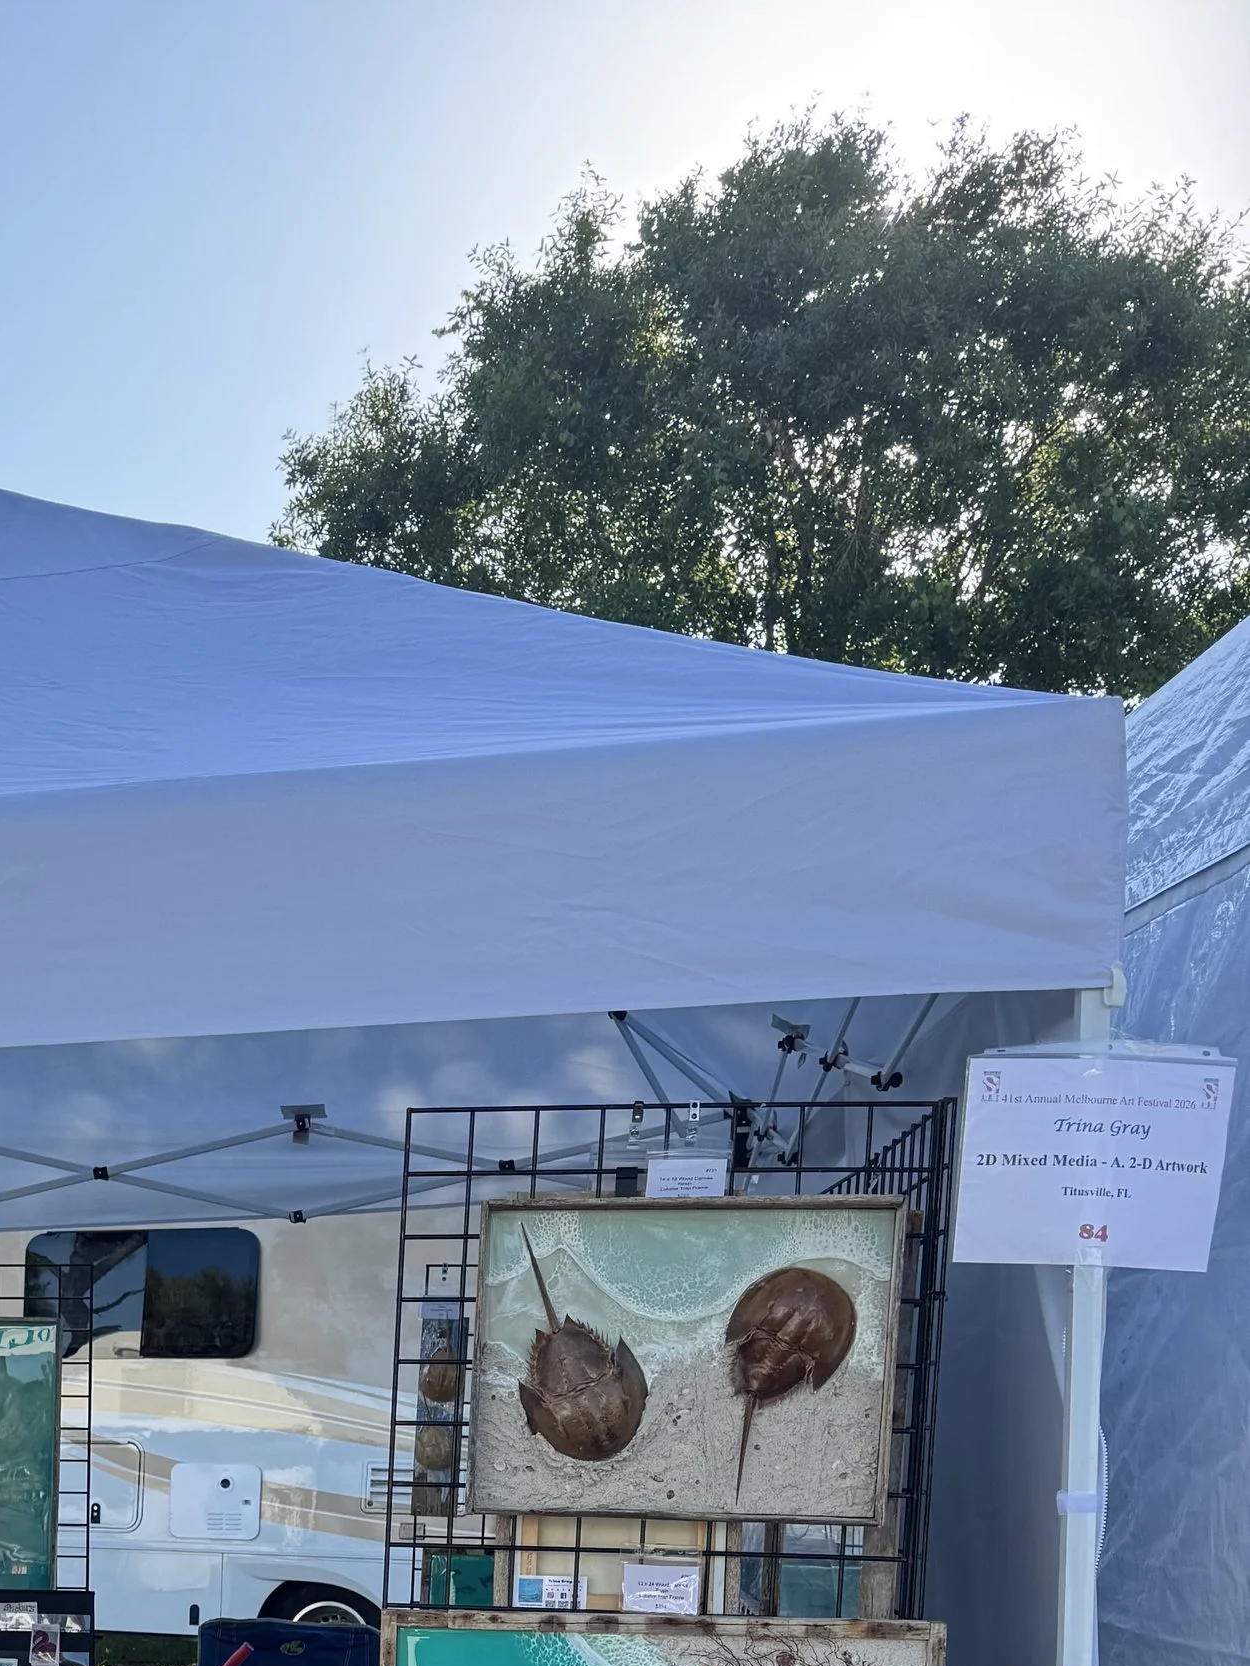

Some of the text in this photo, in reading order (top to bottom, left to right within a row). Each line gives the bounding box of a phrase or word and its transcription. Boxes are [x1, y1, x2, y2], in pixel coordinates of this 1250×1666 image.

[1001, 1094, 1023, 1104] 41st
[1024, 1094, 1062, 1104] Annual
[1064, 1094, 1118, 1105] Melbourne
[1119, 1096, 1135, 1106] Art
[1137, 1096, 1172, 1109] Festival
[1173, 1099, 1197, 1110] 2026
[1053, 1116, 1151, 1141] Trina Gray
[976, 1153, 997, 1166] 2D
[1001, 1153, 1048, 1167] Mixed
[1052, 1154, 1098, 1167] Media
[1110, 1156, 1125, 1169] A.
[1129, 1156, 1153, 1170] 2-D
[1154, 1159, 1208, 1174] Artwork
[1061, 1186, 1132, 1199] Titusville, FL
[1078, 1223, 1109, 1242] 84
